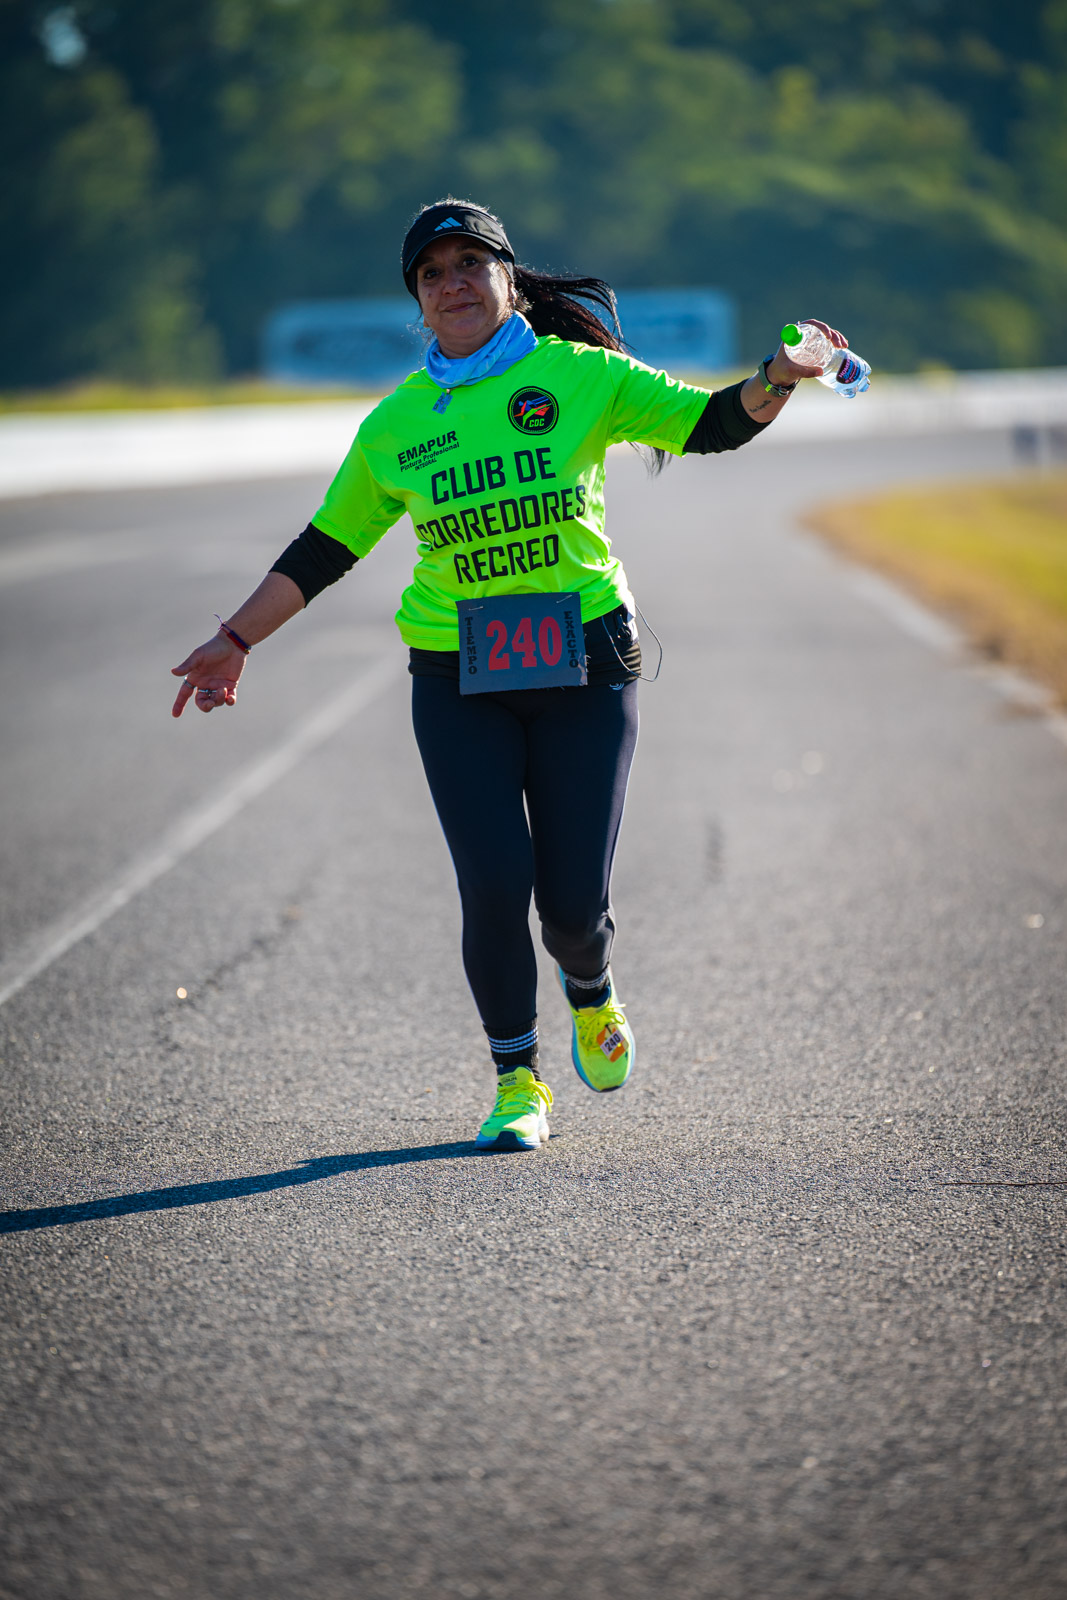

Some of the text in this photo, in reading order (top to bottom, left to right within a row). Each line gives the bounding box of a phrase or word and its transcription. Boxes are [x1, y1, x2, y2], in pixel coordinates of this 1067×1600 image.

[397, 431, 457, 465] EMAPUR
[400, 442, 459, 472] Pintura Profesional
[415, 458, 437, 471] INTEGRAL
[431, 447, 556, 505] CLUB DE
[454, 534, 559, 584] RECREO
[465, 617, 478, 674] TIEMPO
[486, 616, 562, 670] 240
[564, 611, 578, 668] EXACTO
[604, 1033, 621, 1052] 240
